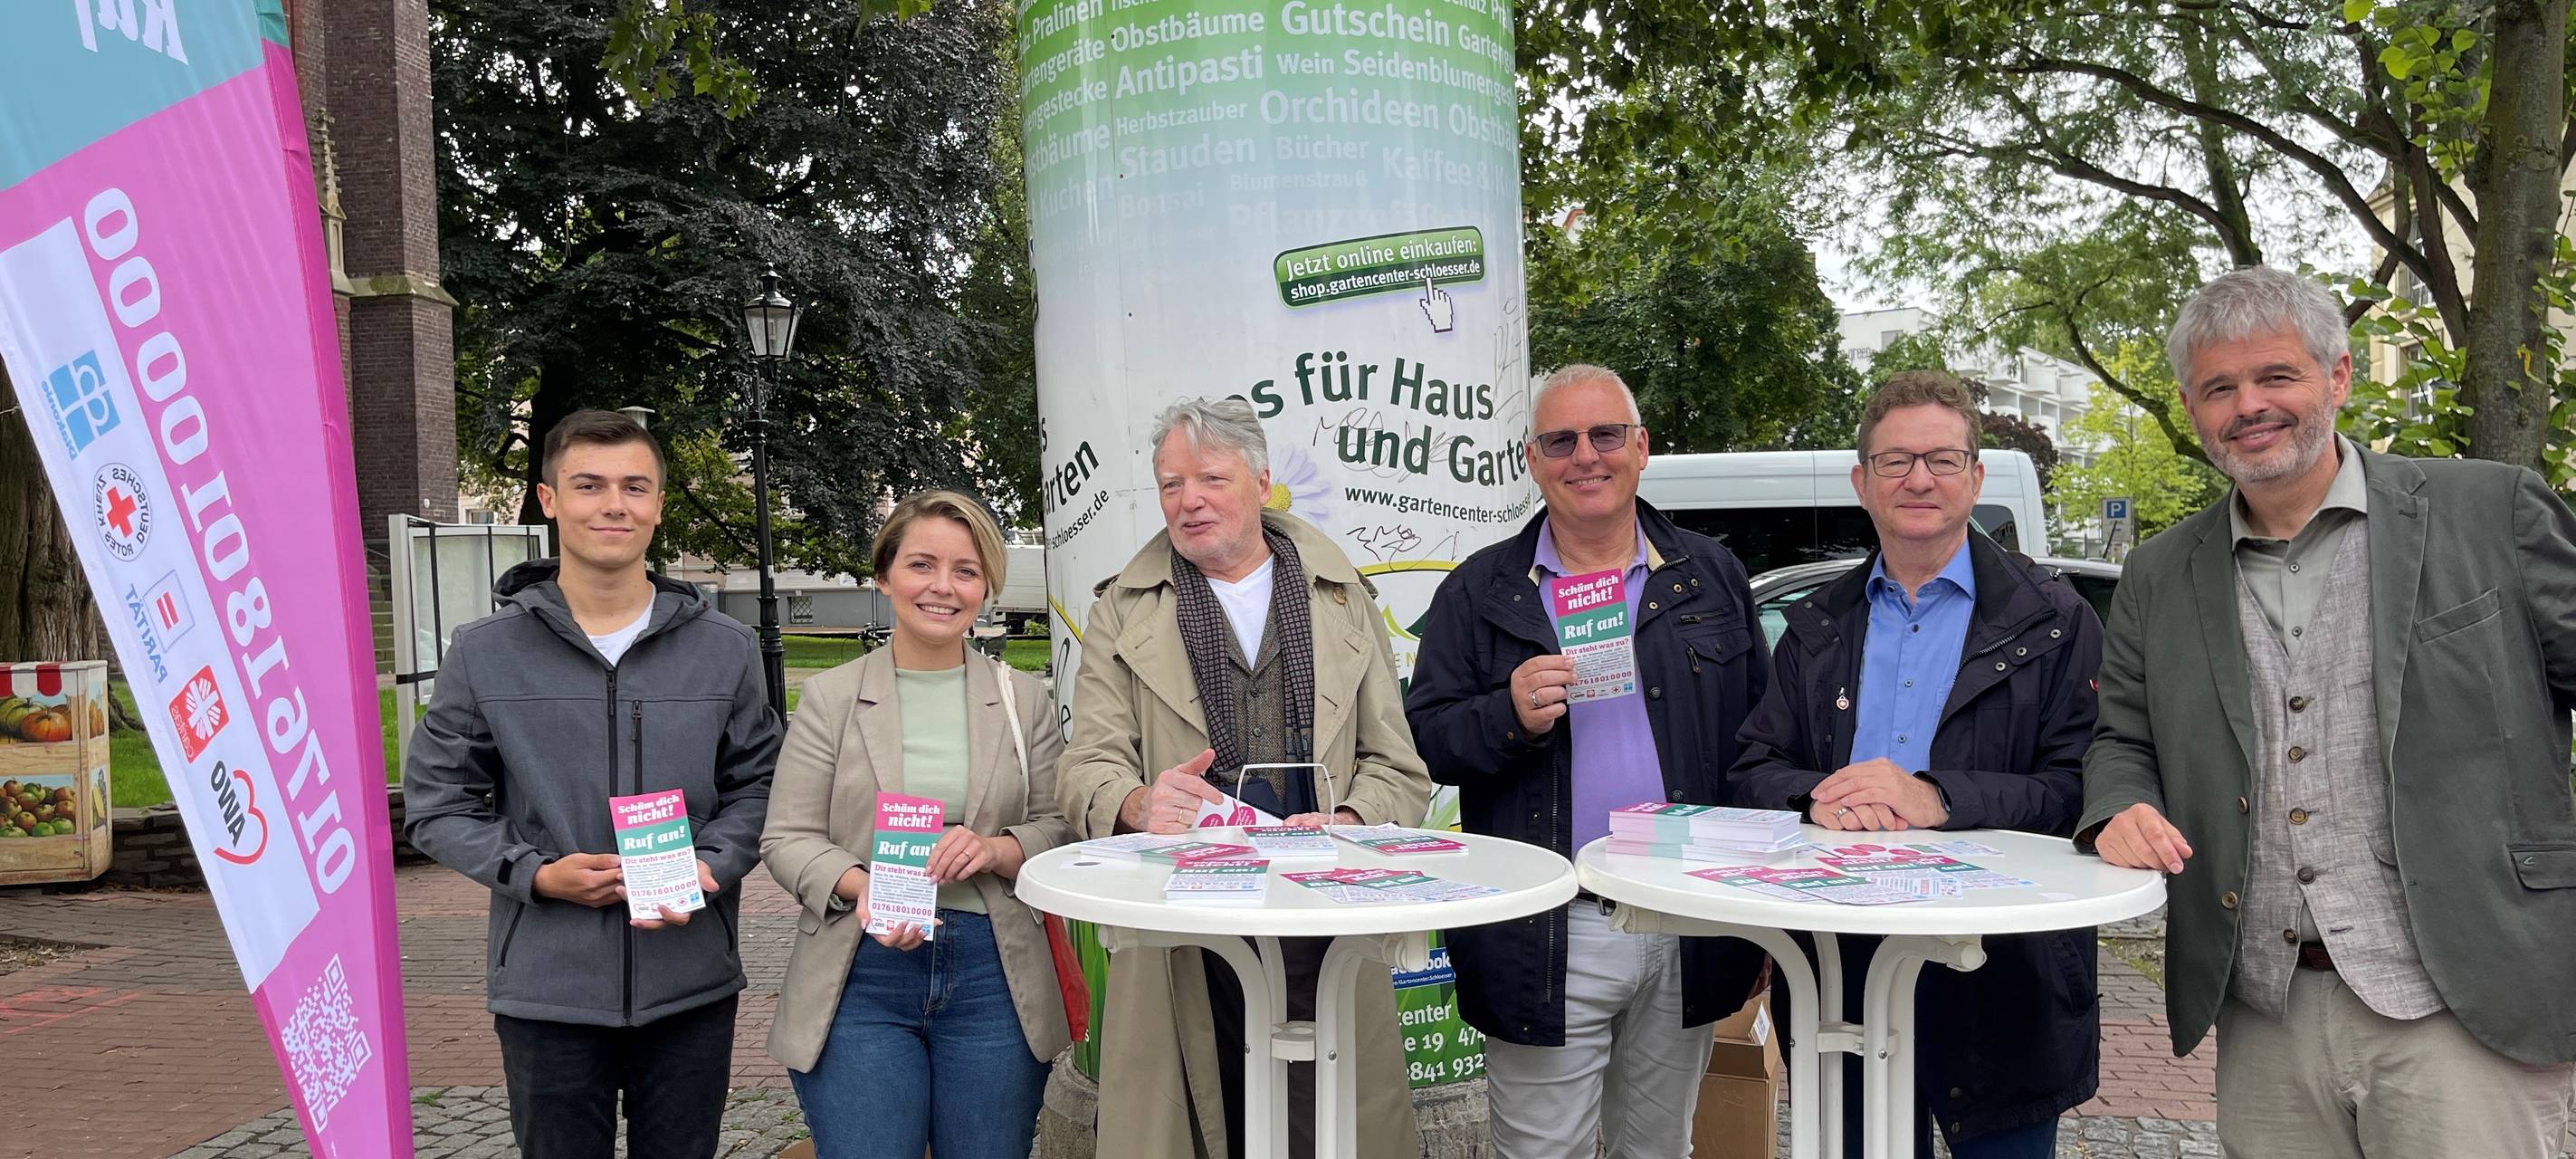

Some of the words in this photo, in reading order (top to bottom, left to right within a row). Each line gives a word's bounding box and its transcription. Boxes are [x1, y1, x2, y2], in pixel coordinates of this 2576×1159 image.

[1032, 0, 1103, 44] Pralinen
[1021, 38, 1105, 98] artengeräte
[1111, 11, 1265, 53] Obstbäume
[1281, 0, 1449, 46] Gutschein
[1115, 44, 1264, 99] Antipasti
[1276, 52, 1335, 74] Wein
[1116, 101, 1247, 137] Herbstzauber
[1260, 87, 1439, 129] Orchideen
[1120, 133, 1255, 178] Stauden
[1275, 135, 1369, 159] Bücher
[1383, 146, 1471, 186] Kaffee
[1286, 253, 1331, 283] Jetzt
[1336, 245, 1394, 269] online
[1399, 235, 1477, 260] einkaufen:
[1291, 259, 1481, 300] shop.gartencenter-schloesser.de
[1294, 350, 1379, 407] für
[1390, 357, 1493, 421] Haus
[1338, 425, 1432, 475] und
[1448, 425, 1530, 487] Garte
[1043, 440, 1099, 515] arten
[2111, 503, 2122, 517] P
[1558, 582, 1594, 599] Schäm
[1595, 574, 1619, 587] dich
[1567, 586, 1613, 610] nicht!
[1564, 618, 1594, 639] Ruf
[1597, 611, 1624, 631] an!
[1579, 645, 1598, 654] steht
[1598, 641, 1615, 649] was
[1615, 638, 1629, 647] zu?
[617, 800, 654, 814] Schäm
[655, 794, 680, 807] dich
[626, 805, 674, 825] nicht!
[882, 802, 917, 813] Schäm
[918, 803, 940, 815] dich
[888, 813, 933, 829] nicht!
[623, 832, 654, 850] Ruf
[657, 825, 685, 844] an!
[877, 840, 909, 859] Ruf
[874, 864, 886, 872] Dir
[1398, 1003, 1453, 1027] enter
[1422, 1032, 1445, 1052] 19
[1452, 1053, 1486, 1078] 932
